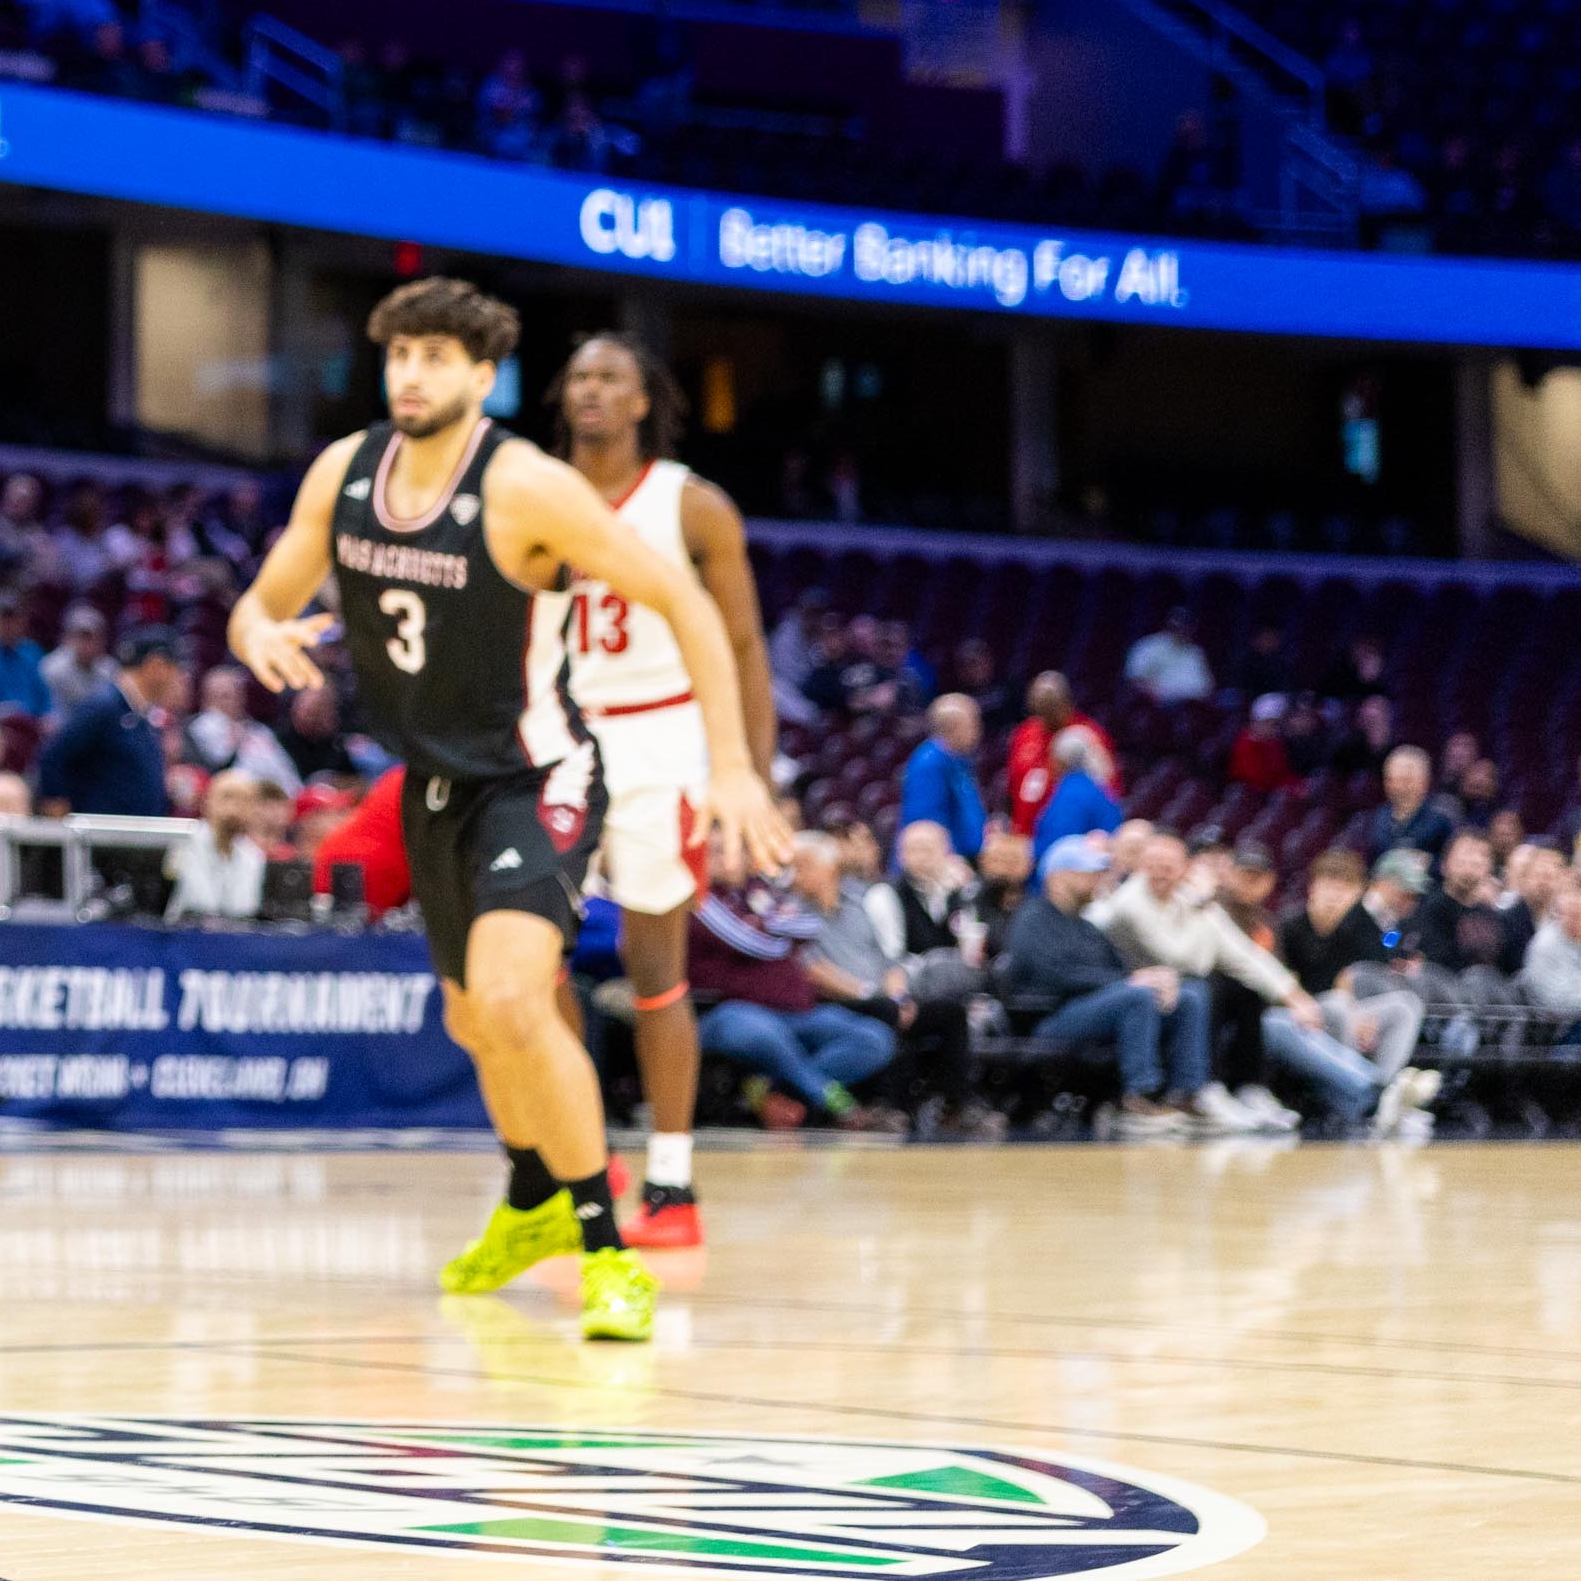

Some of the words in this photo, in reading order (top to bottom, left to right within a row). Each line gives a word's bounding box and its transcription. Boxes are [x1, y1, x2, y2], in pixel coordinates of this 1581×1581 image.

[580, 189, 675, 262] CU1
[720, 208, 845, 277] Better
[853, 222, 1028, 307] Banking
[1033, 240, 1110, 301] For
[378, 588, 427, 675] 3
[574, 592, 629, 655] 13
[177, 968, 437, 1035] TOURNAMENT
